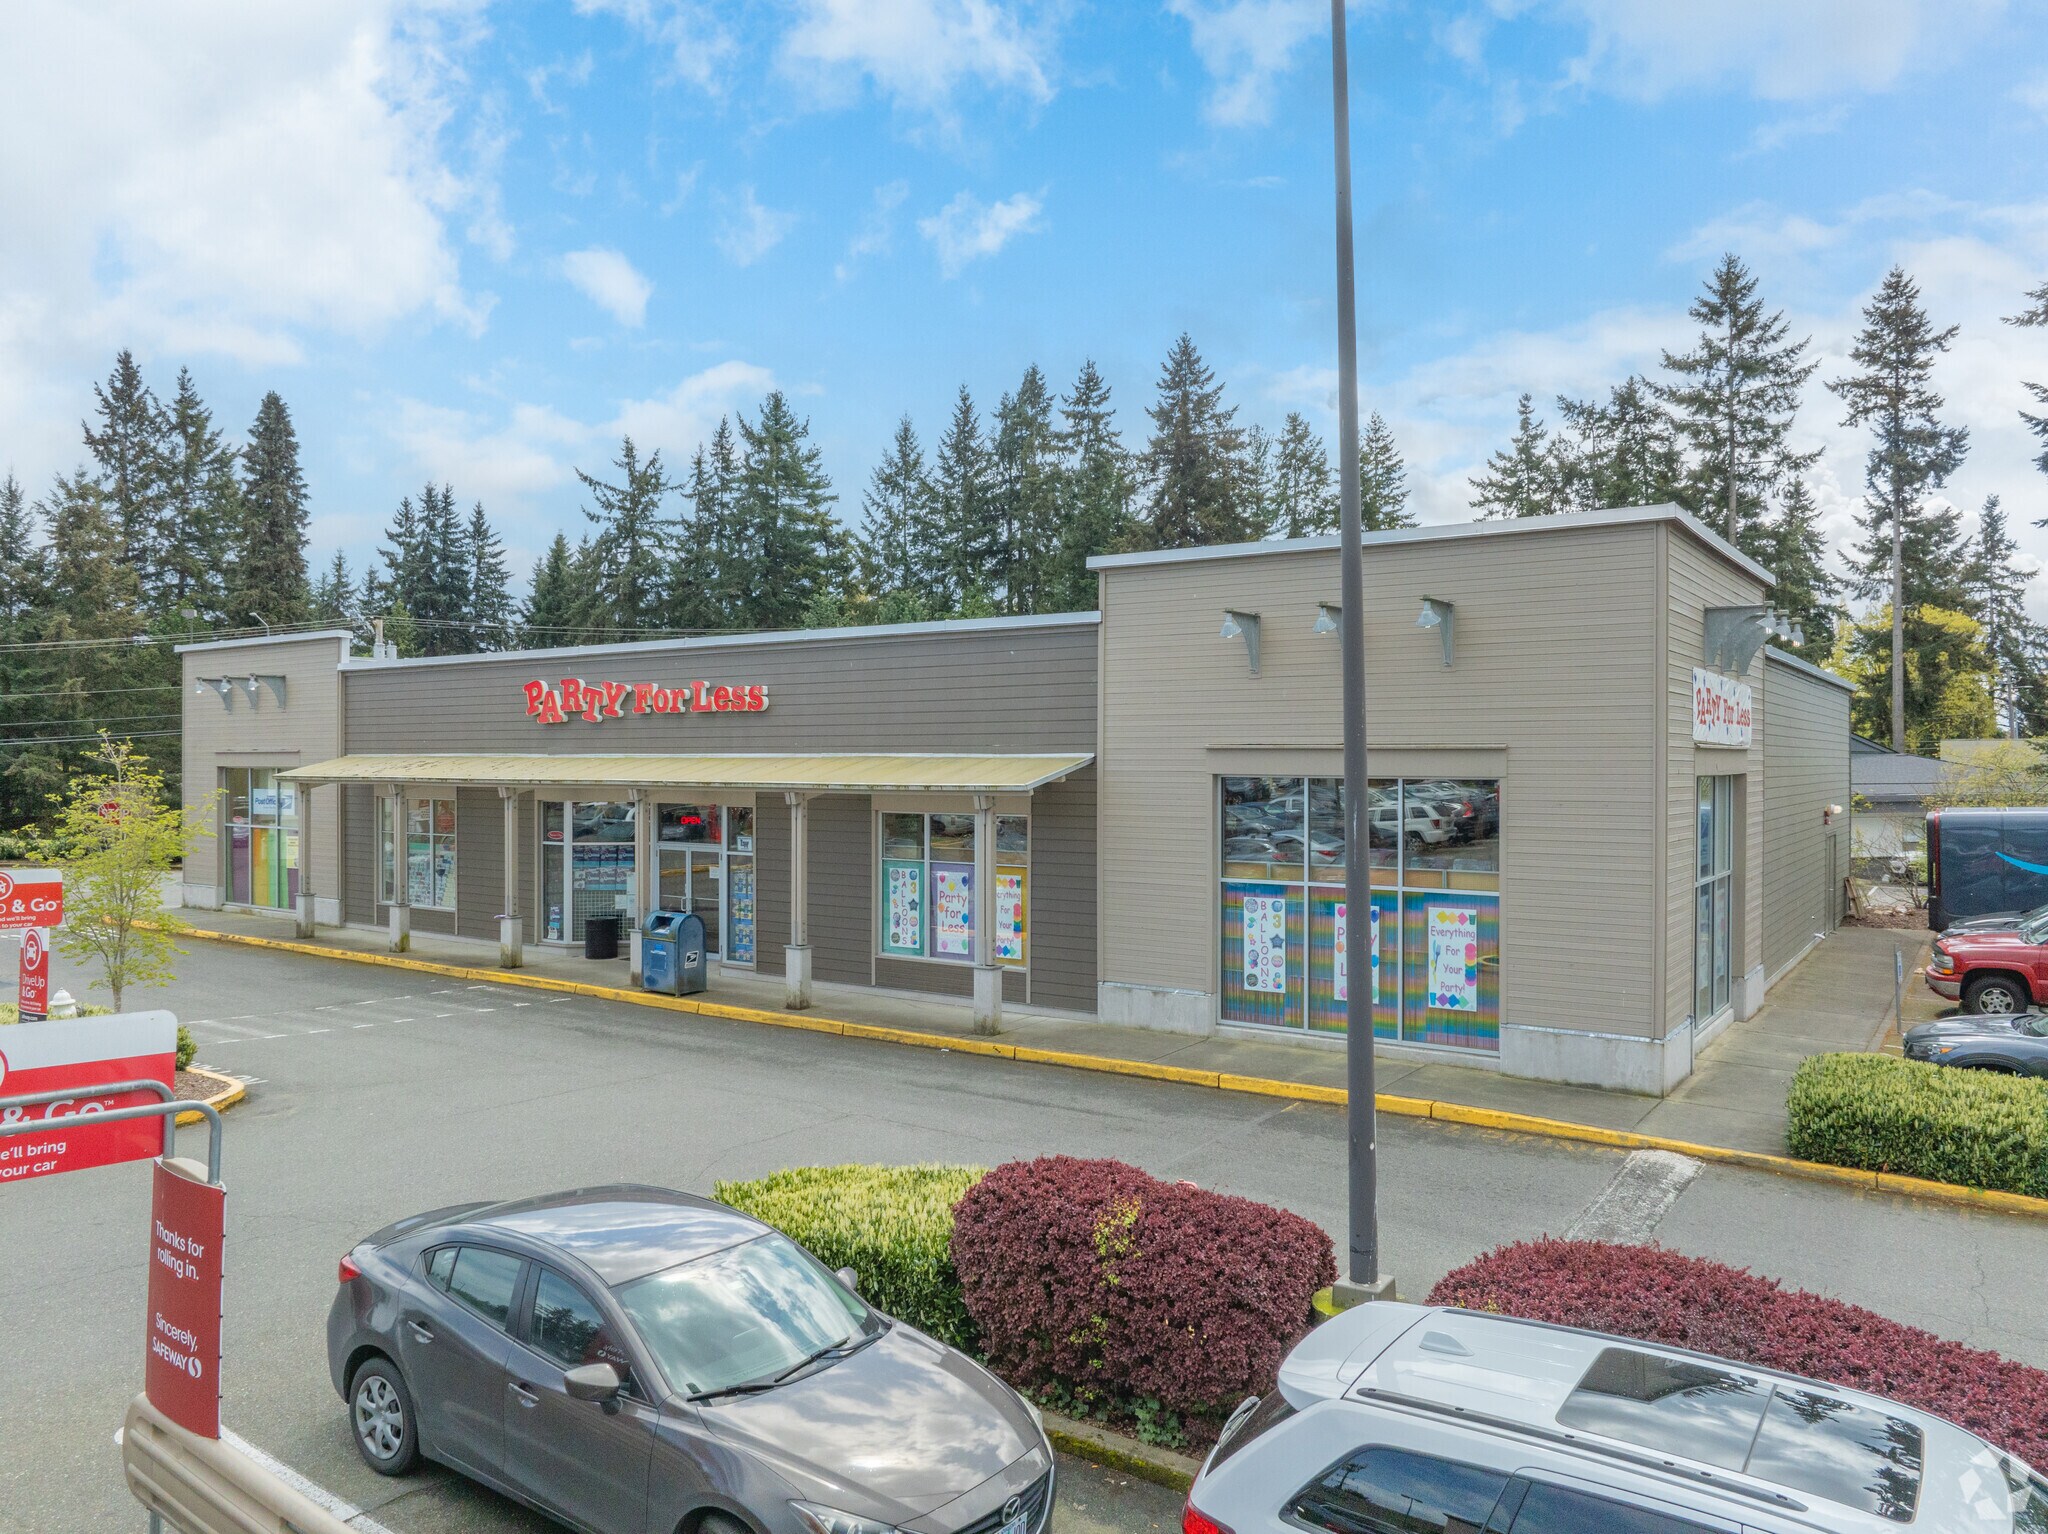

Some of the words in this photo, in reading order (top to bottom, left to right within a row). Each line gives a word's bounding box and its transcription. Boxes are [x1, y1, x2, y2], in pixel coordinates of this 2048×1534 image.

[523, 678, 632, 723] PARTY
[633, 683, 690, 714] For
[690, 681, 769, 712] Less
[1696, 687, 1721, 727] PARTY
[1723, 698, 1735, 725] For
[1736, 701, 1751, 727] Less
[680, 815, 701, 824] OPEN
[11, 898, 26, 914] &
[939, 890, 967, 908] Party
[901, 870, 909, 945] BALLOONS
[944, 906, 961, 919] for
[1000, 905, 1011, 914] For
[941, 920, 965, 933] Less
[998, 920, 1013, 929] Your
[1430, 925, 1476, 941] Everything
[1260, 900, 1270, 989] BALLOONS
[1445, 945, 1461, 956] For
[1443, 963, 1463, 975] Your
[1440, 981, 1466, 995] Party!
[0, 1145, 23, 1160] e'll
[27, 1141, 67, 1157] bring
[33, 1160, 58, 1172] car
[156, 1219, 186, 1252] Thanks
[187, 1236, 204, 1259] for
[157, 1246, 184, 1279] rolling
[185, 1259, 199, 1281] in.
[155, 1311, 198, 1353] Sincerely,
[152, 1335, 188, 1370] SAFEWAY
